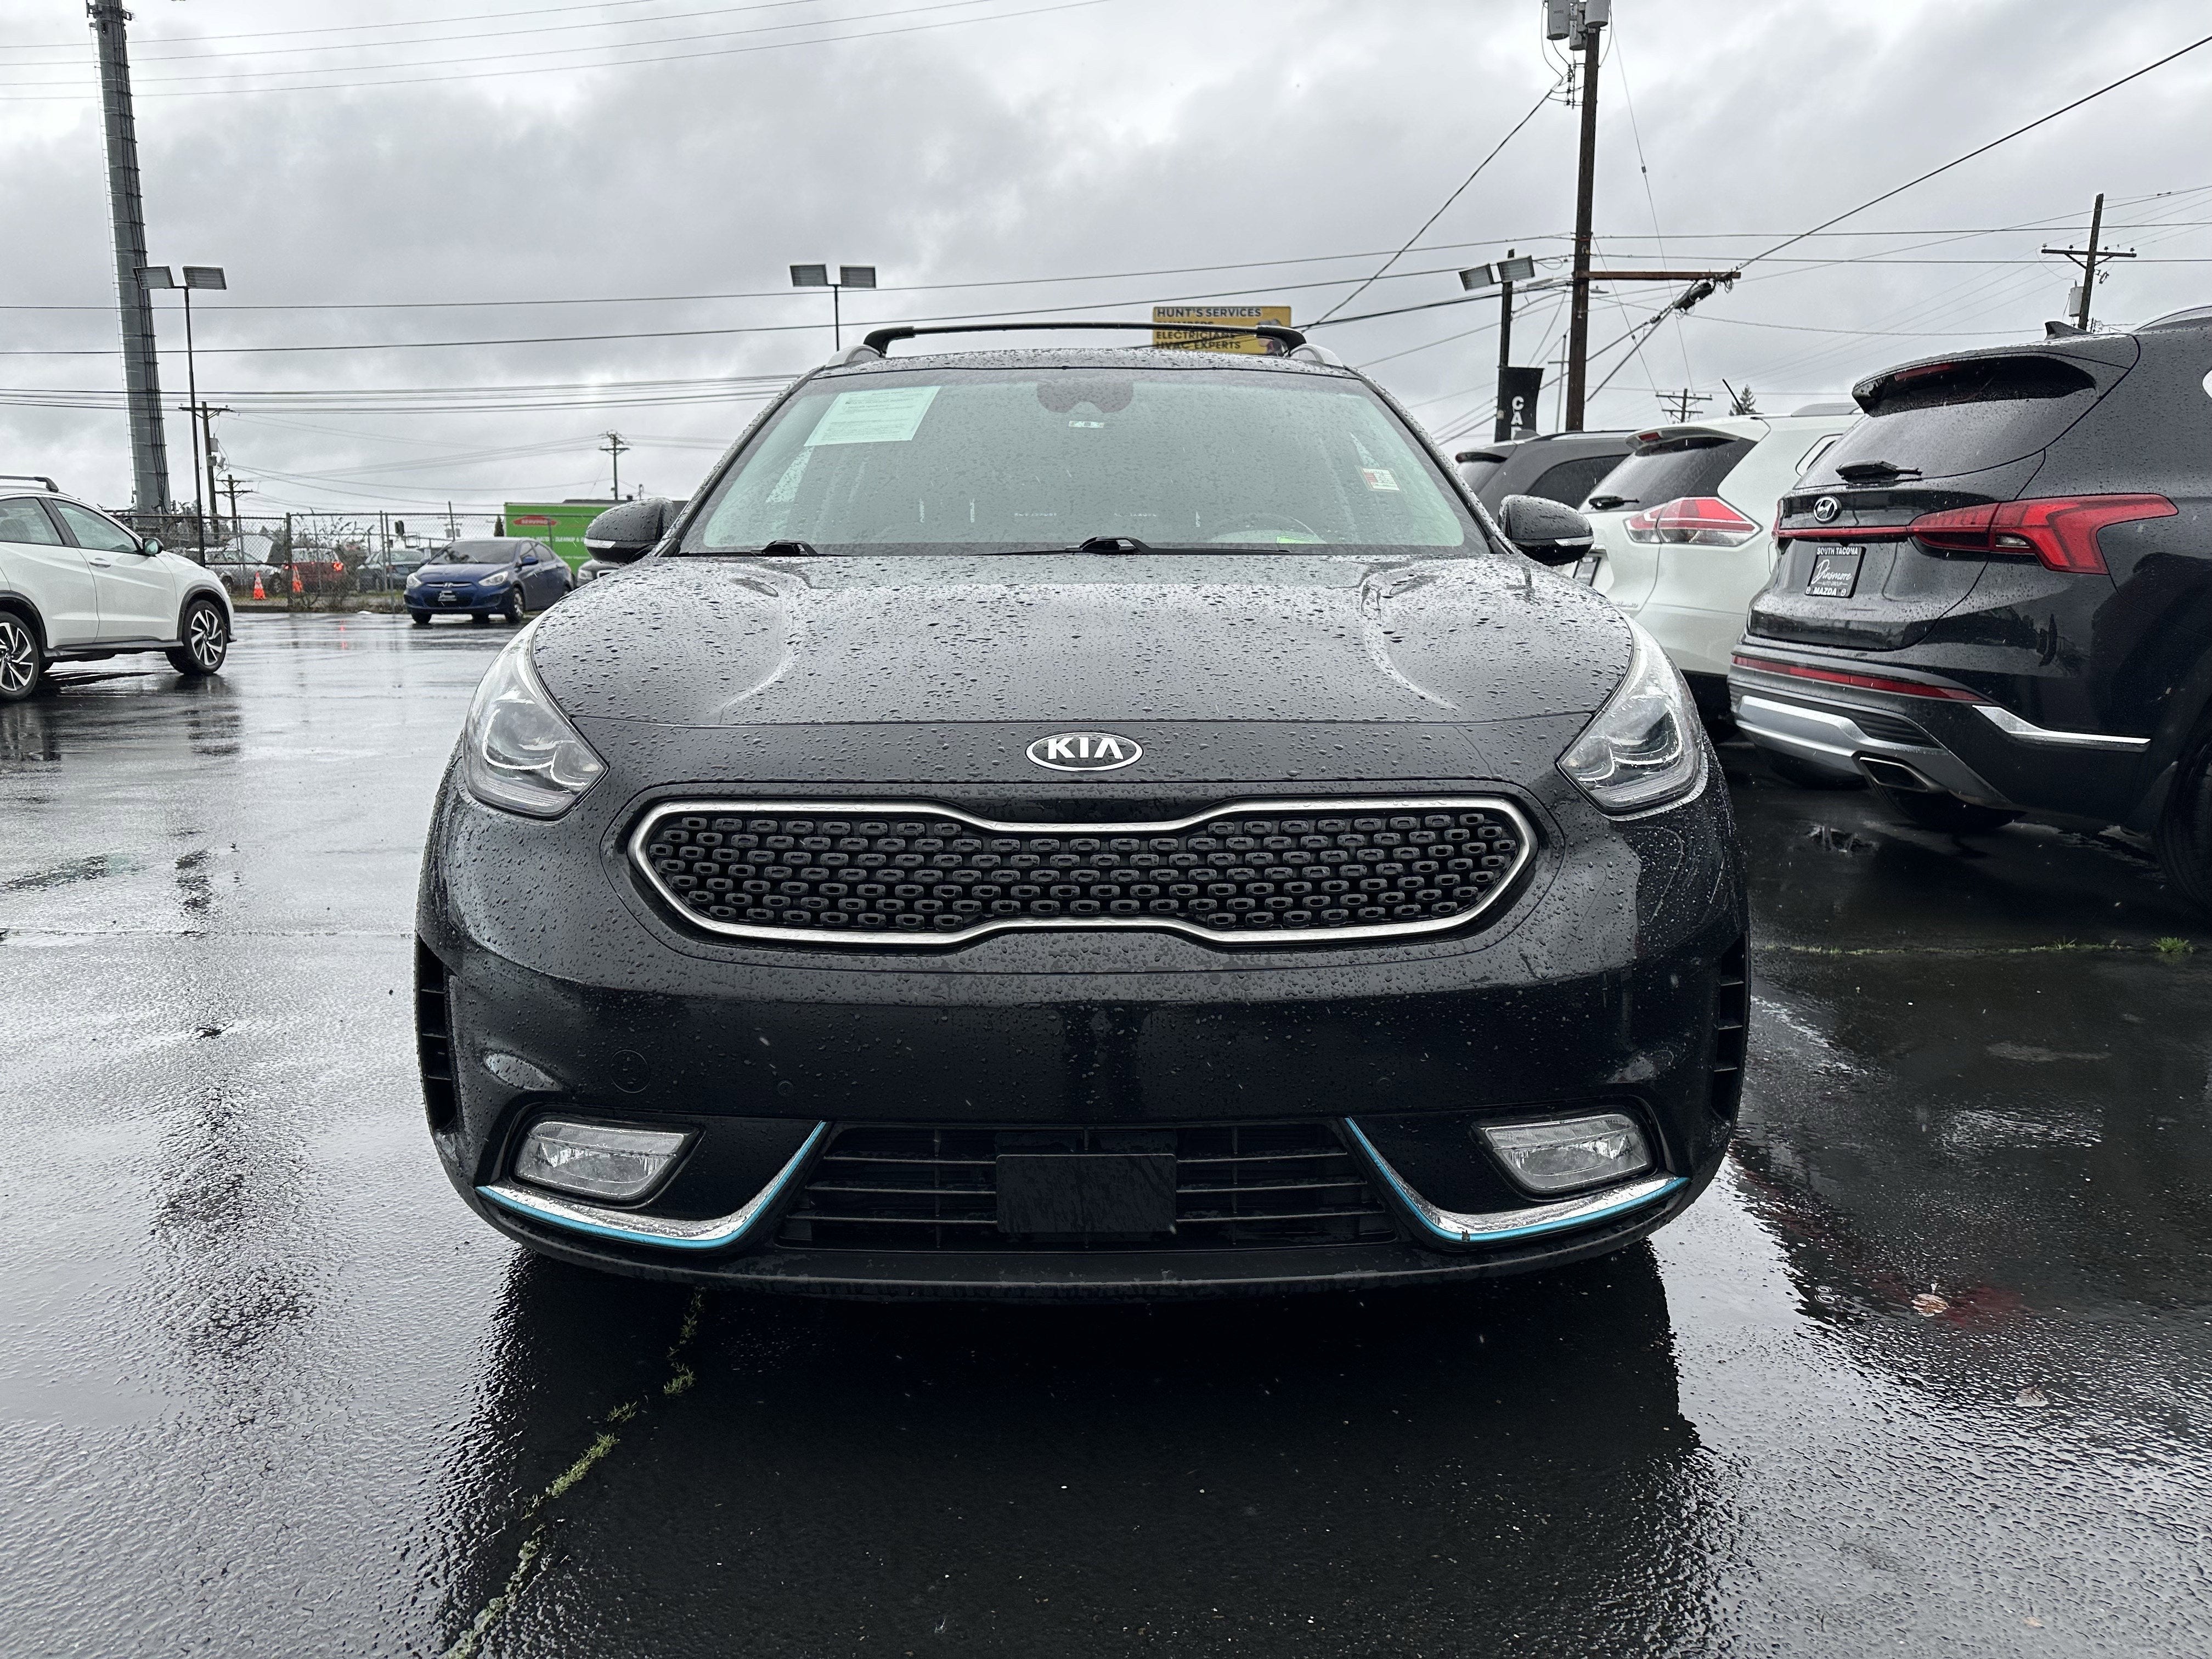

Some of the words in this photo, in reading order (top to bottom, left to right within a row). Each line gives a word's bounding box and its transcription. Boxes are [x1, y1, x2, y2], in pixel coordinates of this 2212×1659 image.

[1157, 308, 1203, 317] HUNT'S
[1205, 308, 1261, 317] SERVICES
[1194, 340, 1241, 349] EXPERTS
[1816, 547, 1835, 555] SOUTH
[1836, 547, 1858, 555] TACOMA
[1813, 586, 1837, 596] MAZDA
[1047, 737, 1124, 759] KIA
